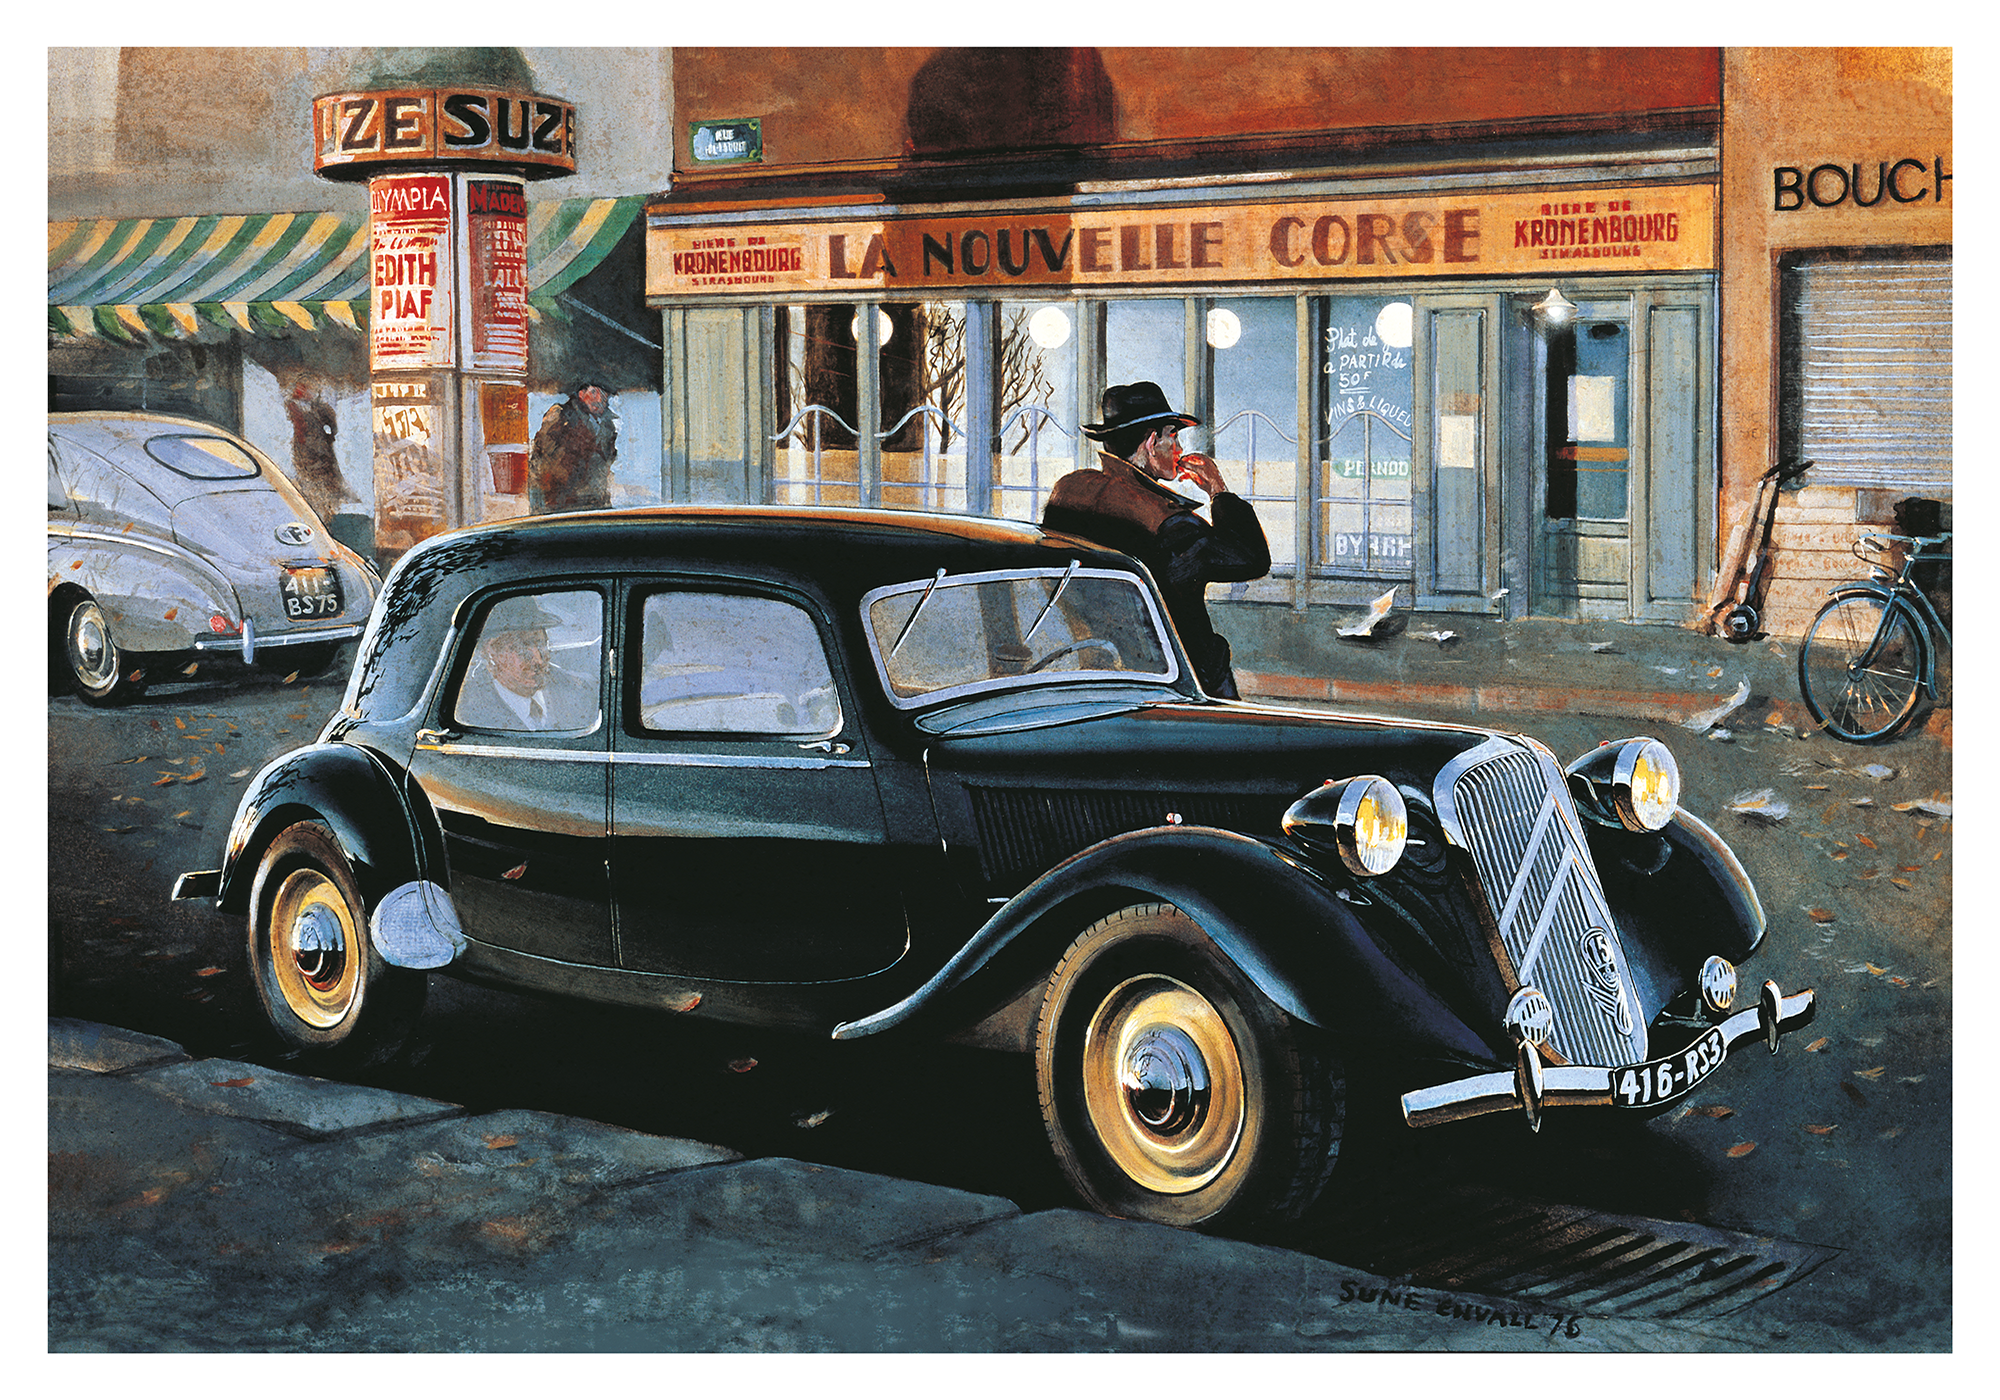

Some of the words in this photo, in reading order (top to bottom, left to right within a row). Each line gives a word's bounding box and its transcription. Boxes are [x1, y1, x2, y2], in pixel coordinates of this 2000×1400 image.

[829, 233, 897, 279] LA
[923, 221, 1224, 277] NOUVELLE
[1269, 208, 1481, 268] CORSE
[1515, 212, 1679, 248] KRONENBOURG
[374, 252, 437, 287] EDITH
[673, 247, 801, 275] KRONENBOURG
[381, 289, 433, 320] PIAF
[1619, 1031, 1720, 1105] 416-RS3
